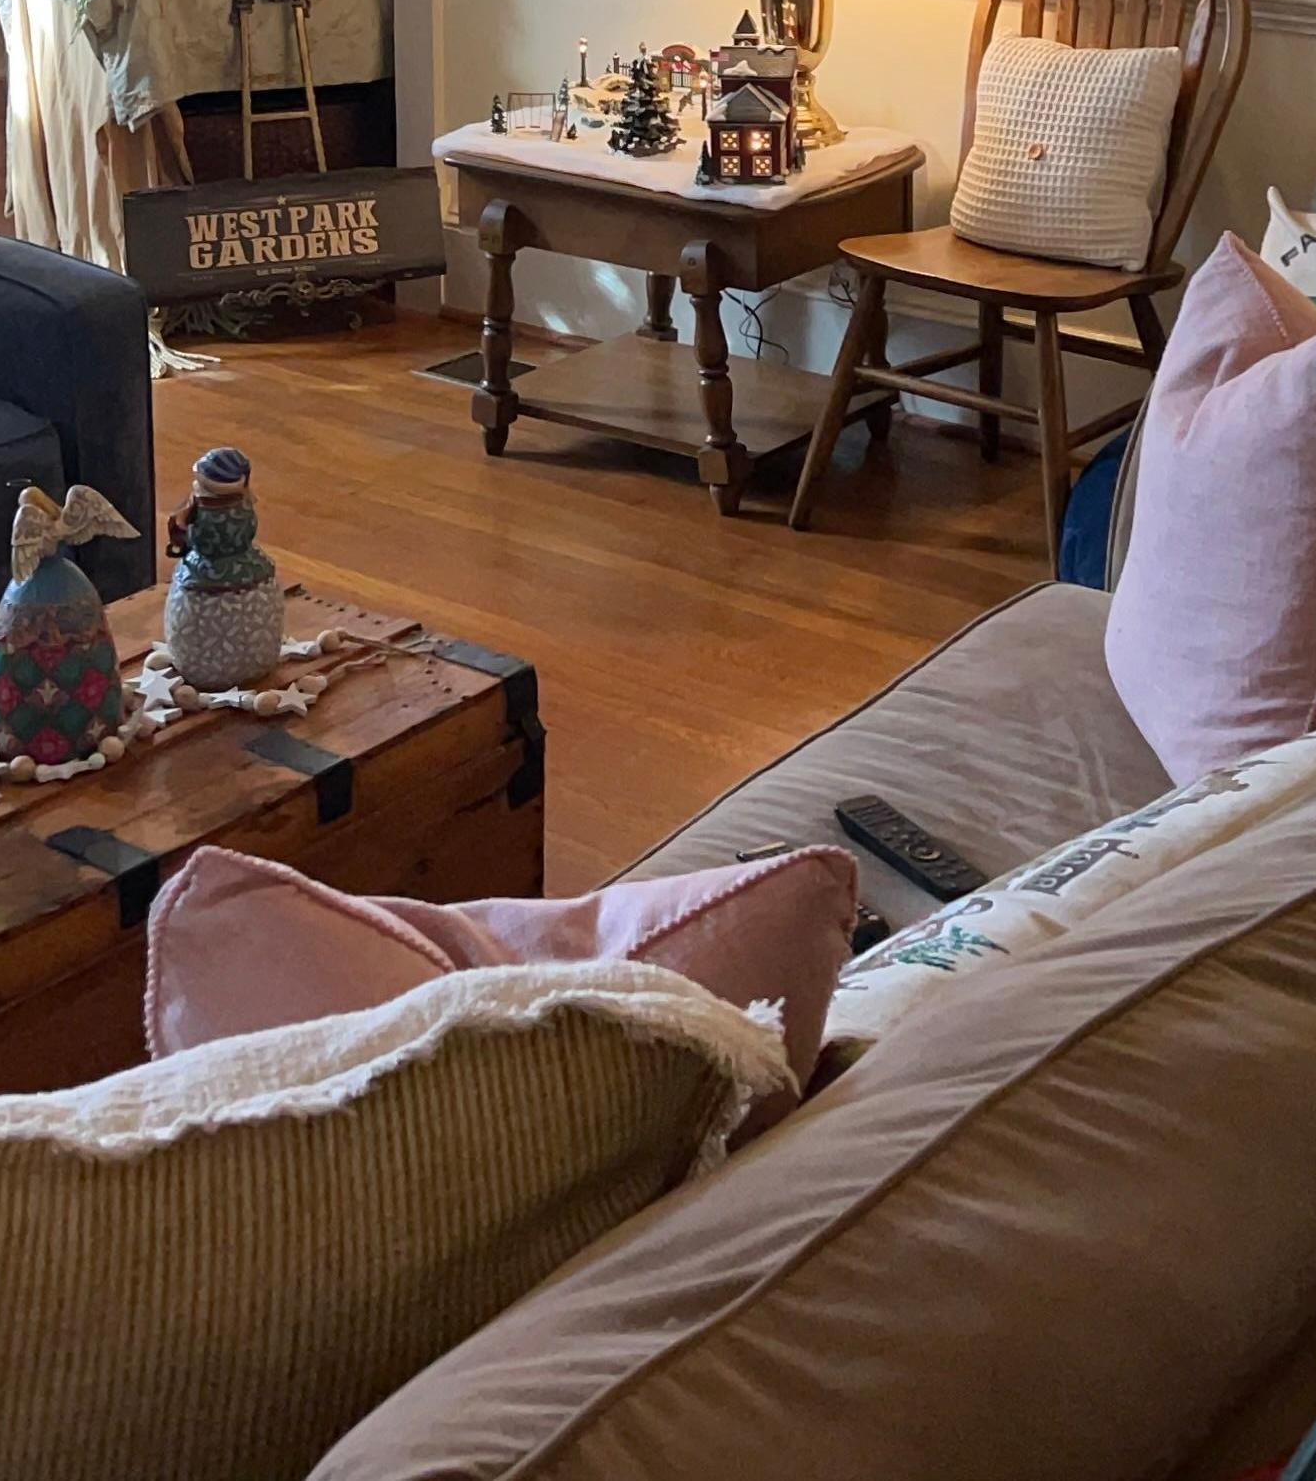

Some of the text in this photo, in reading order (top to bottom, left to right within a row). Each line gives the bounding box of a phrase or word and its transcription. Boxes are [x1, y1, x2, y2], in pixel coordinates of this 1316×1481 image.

[185, 199, 379, 243] WEST PARK
[189, 228, 379, 270] GARDENS
